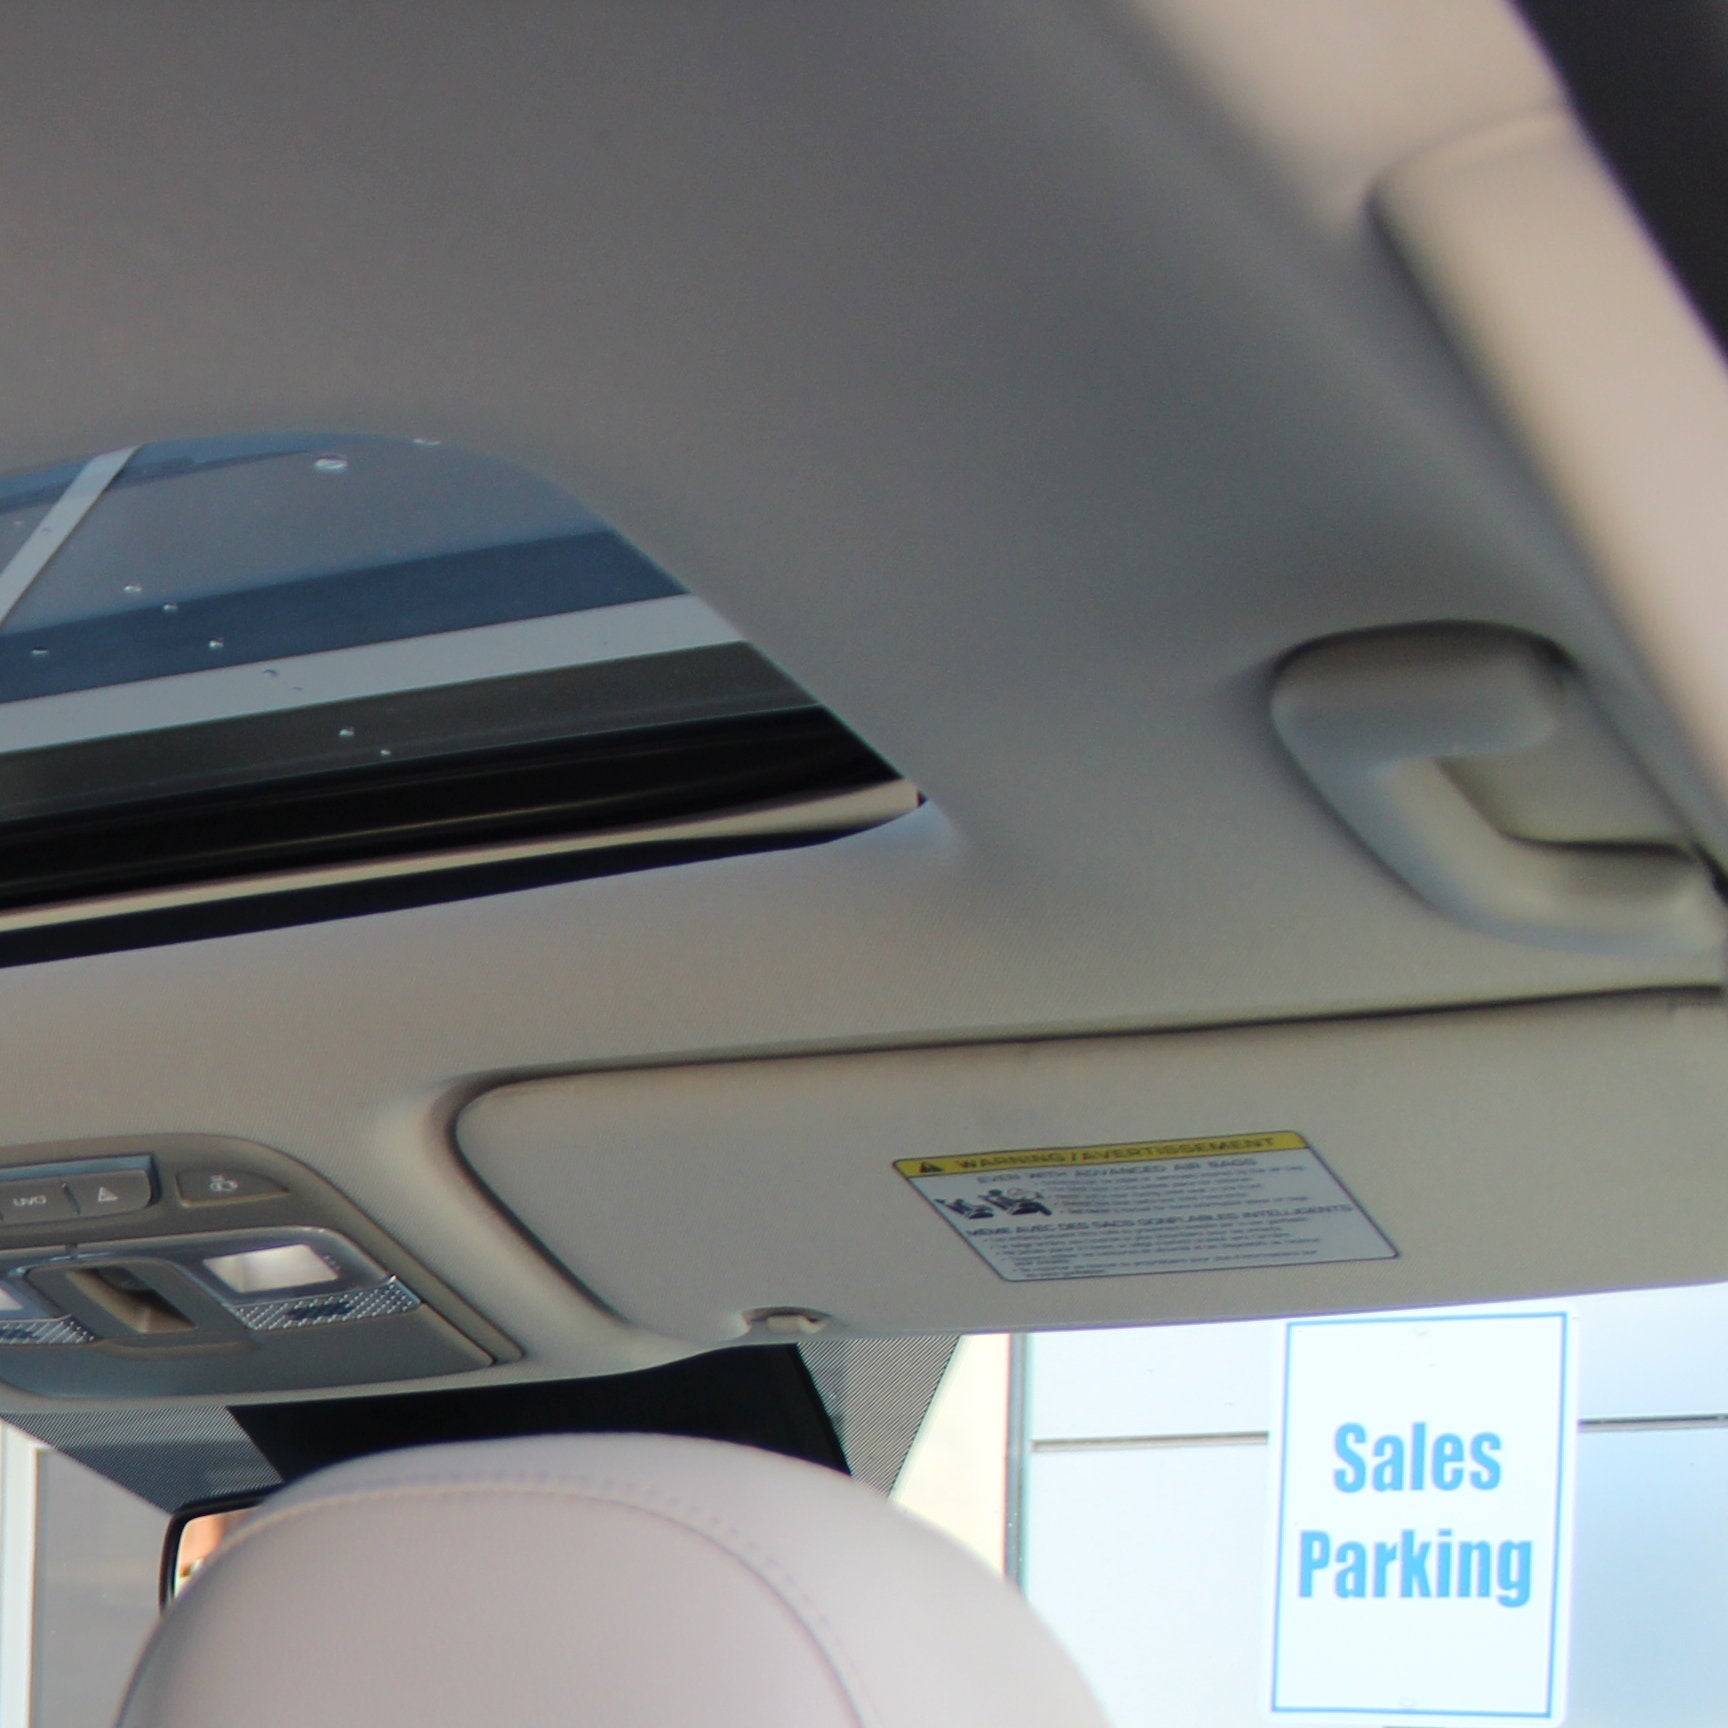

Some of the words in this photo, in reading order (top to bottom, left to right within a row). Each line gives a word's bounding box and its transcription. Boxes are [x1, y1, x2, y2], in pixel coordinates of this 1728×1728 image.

[958, 1154, 1064, 1168] WARNING
[1333, 1422, 1503, 1493] Sales
[1297, 1528, 1533, 1608] Parking
